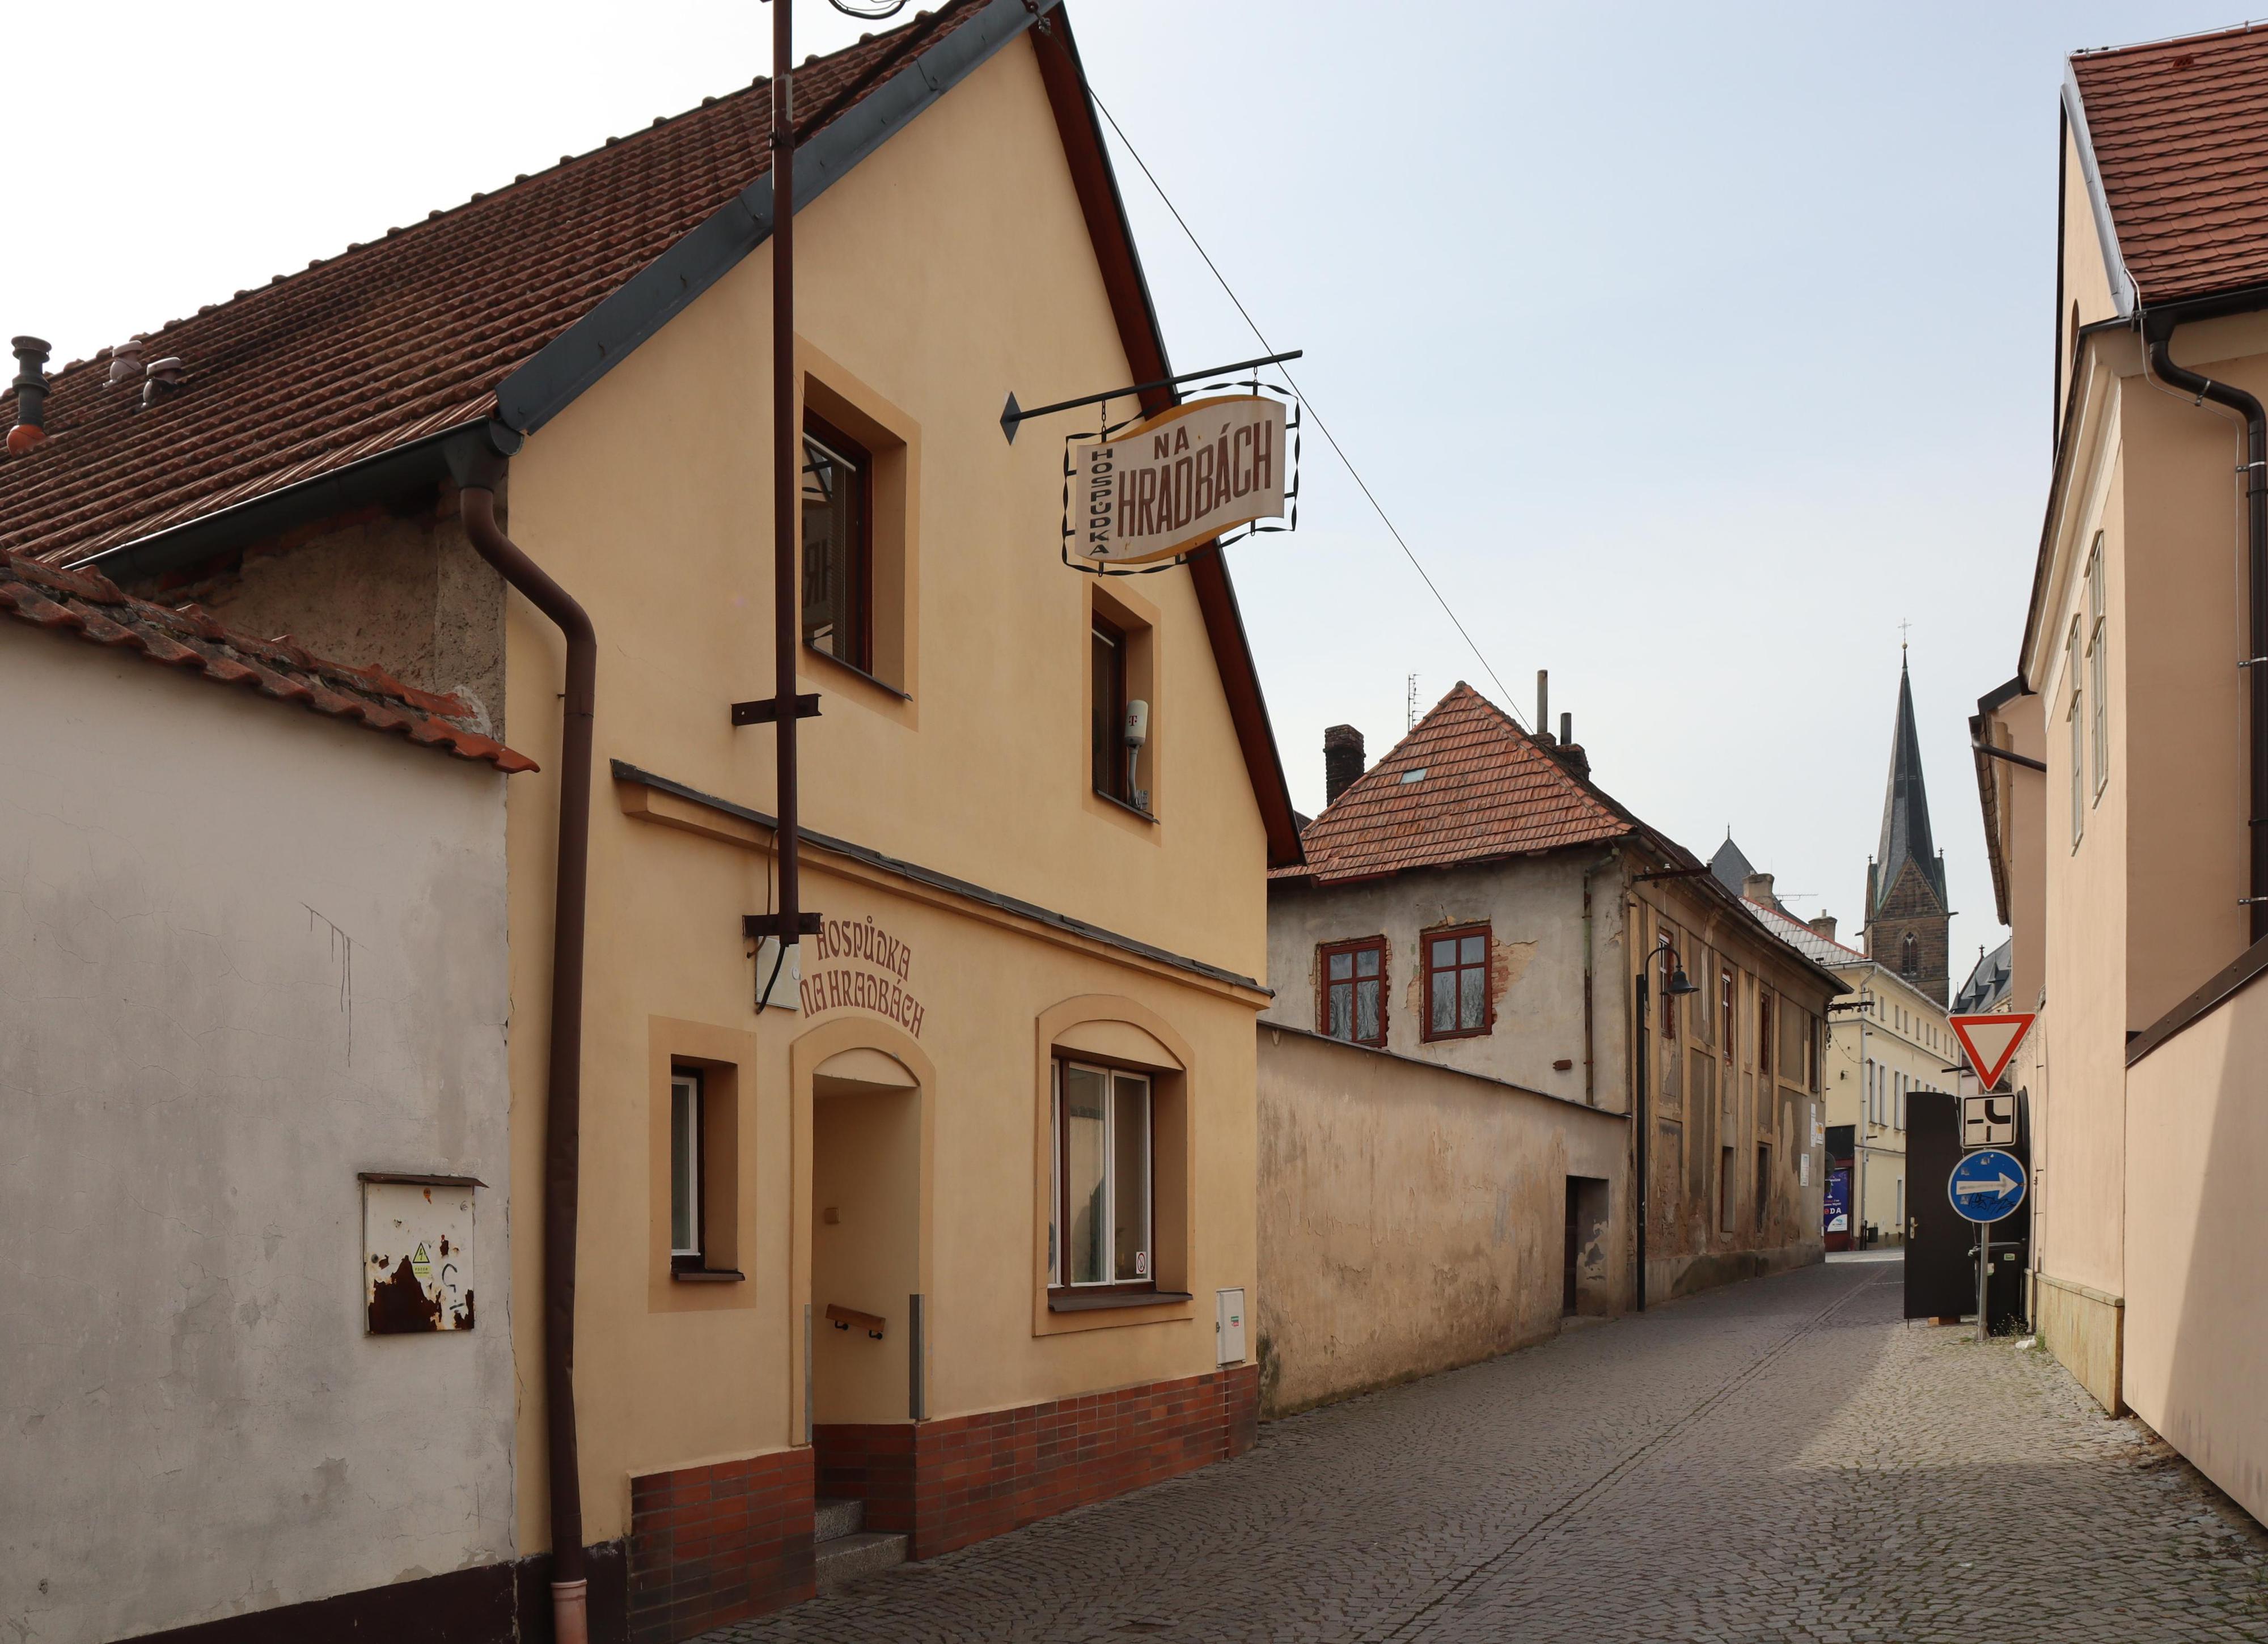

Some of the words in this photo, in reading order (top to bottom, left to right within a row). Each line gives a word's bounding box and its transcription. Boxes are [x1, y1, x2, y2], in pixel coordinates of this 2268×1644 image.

[1154, 425, 1190, 460] NA
[1090, 448, 1113, 556] HOSPŮDKA
[1117, 420, 1272, 537] HRADBÁCH
[816, 916, 911, 982] HOSPŮDKA
[800, 973, 827, 1019] NA
[827, 970, 925, 1039] HRADBÁCH
